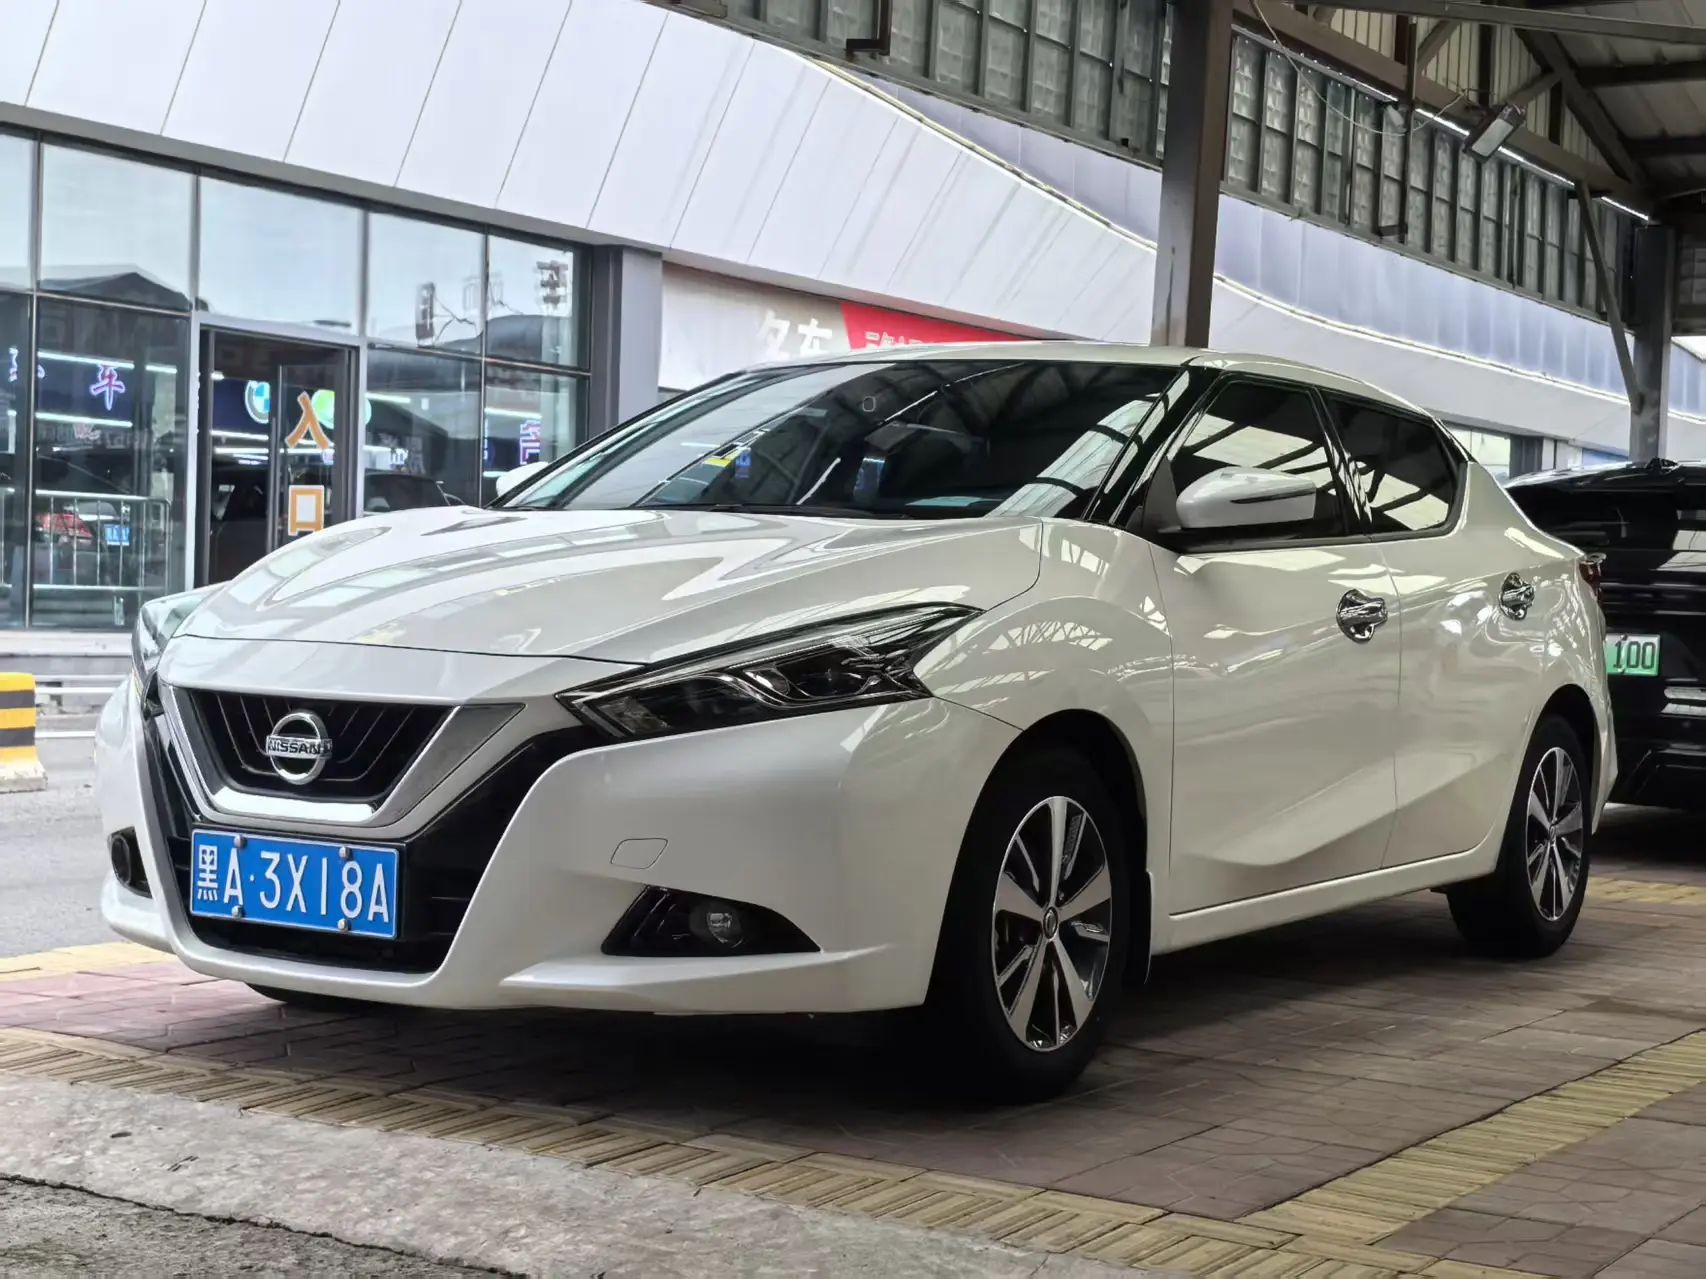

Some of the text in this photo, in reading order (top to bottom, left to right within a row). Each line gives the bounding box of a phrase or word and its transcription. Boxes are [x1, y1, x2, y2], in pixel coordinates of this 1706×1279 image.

[285, 391, 335, 536] 入口
[1612, 640, 1656, 670] 100
[267, 738, 322, 756] NISSAN
